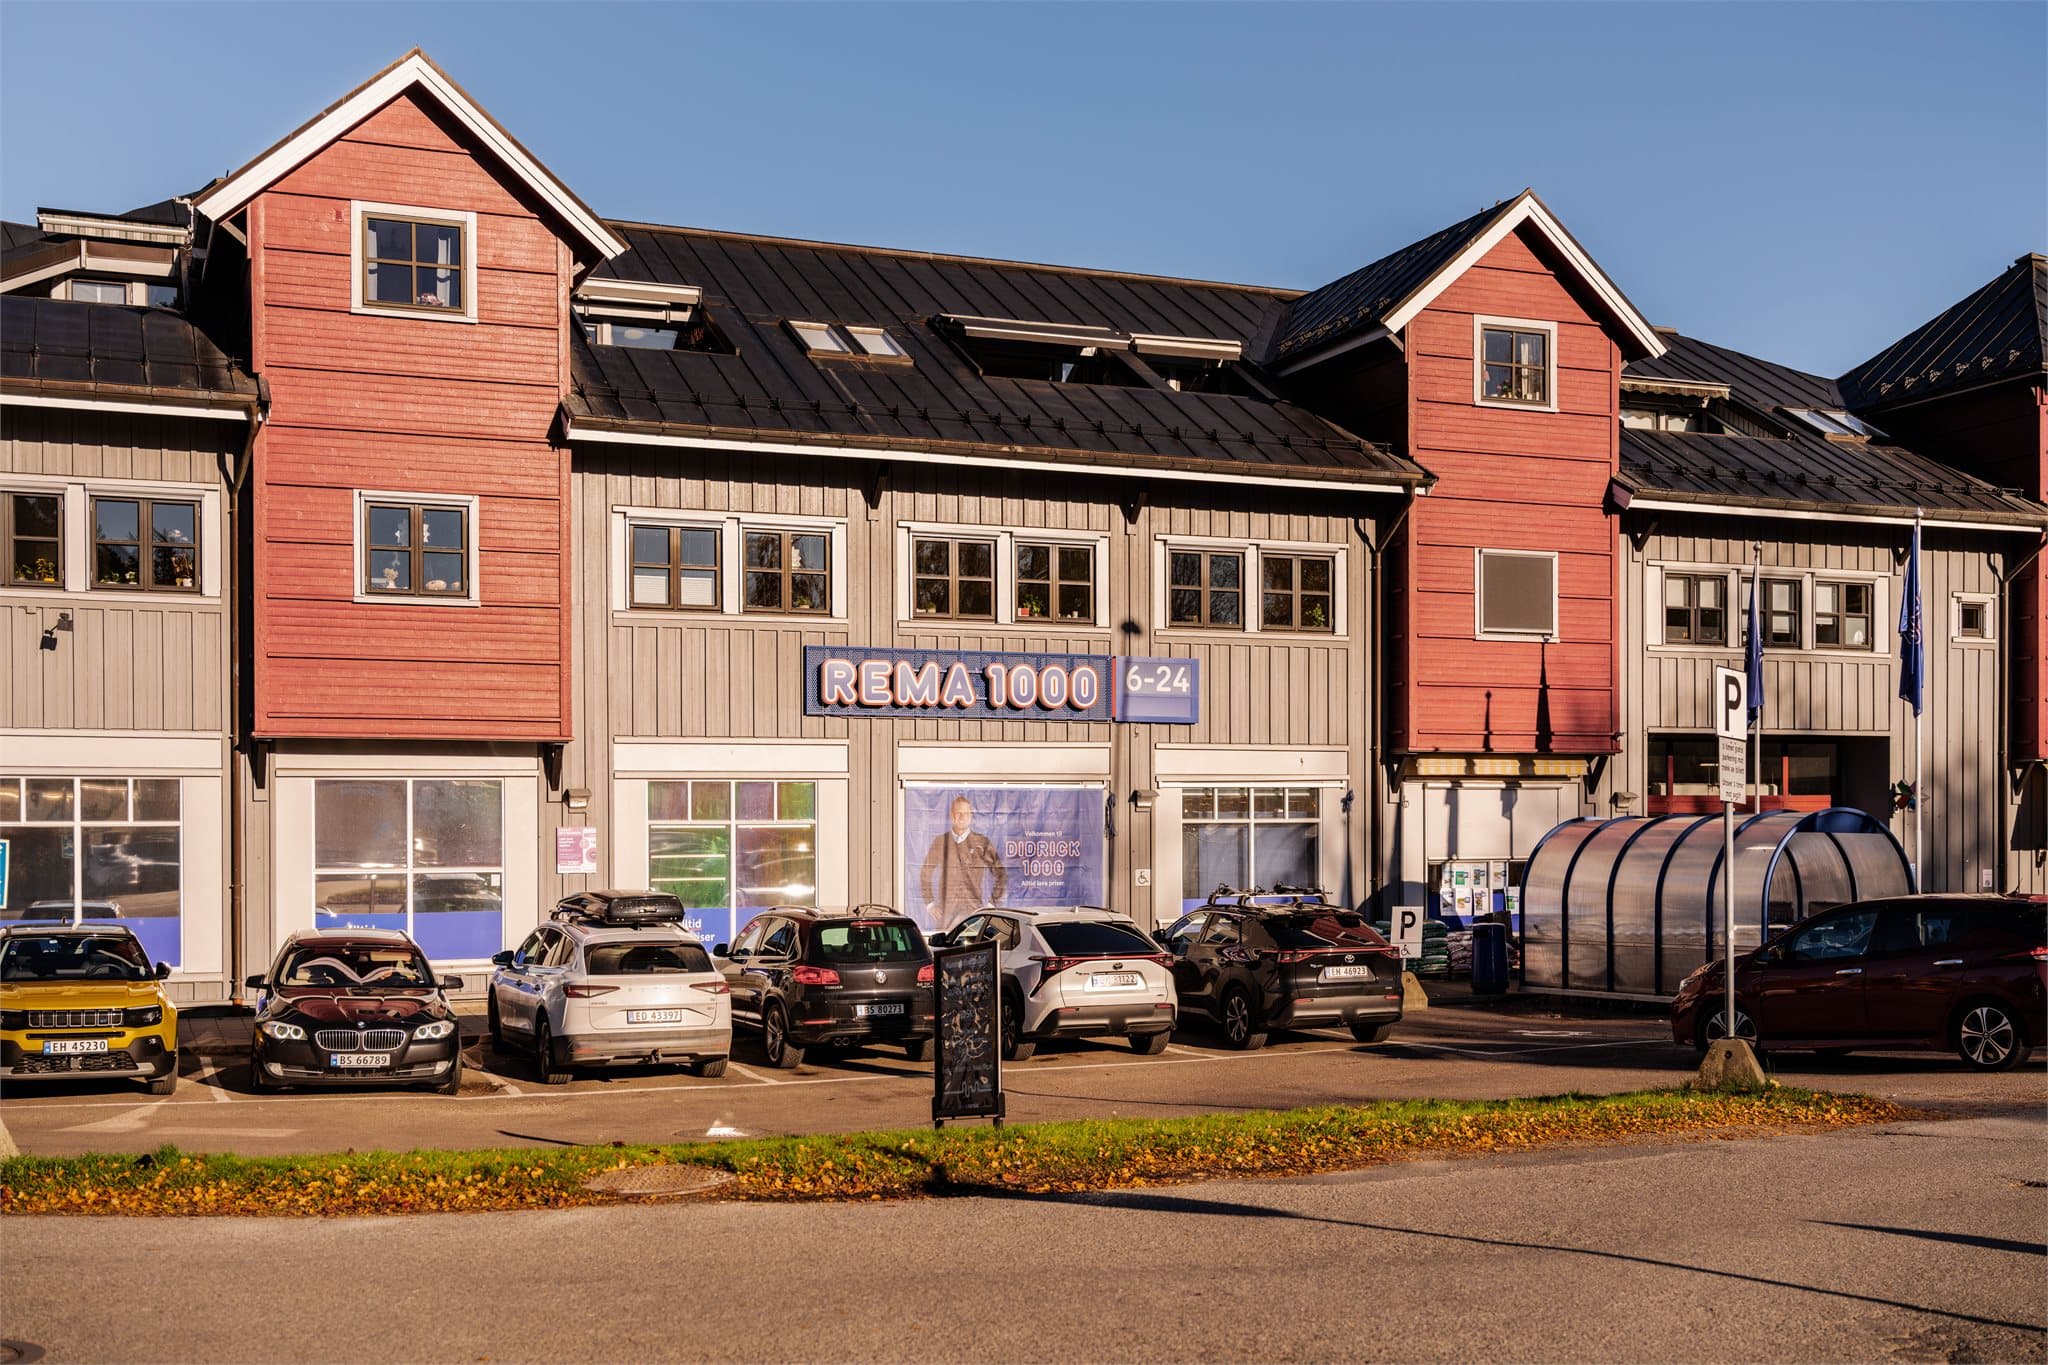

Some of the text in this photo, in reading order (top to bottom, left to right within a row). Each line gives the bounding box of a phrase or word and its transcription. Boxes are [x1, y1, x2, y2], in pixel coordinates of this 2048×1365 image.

[821, 658, 1098, 709] REMA 1000
[1126, 665, 1191, 694] 6-24
[1725, 674, 1741, 732] P
[1005, 840, 1080, 857] DIDRICK
[1022, 860, 1064, 876] 1000
[1049, 880, 1064, 888] priser
[682, 919, 702, 928] lltid
[1400, 911, 1416, 939] P
[697, 933, 716, 941] iser
[635, 1010, 679, 1021] ED 43397
[864, 1006, 875, 1014] BS
[52, 1041, 106, 1052] EH 45230
[340, 1056, 387, 1065] BS 66789
